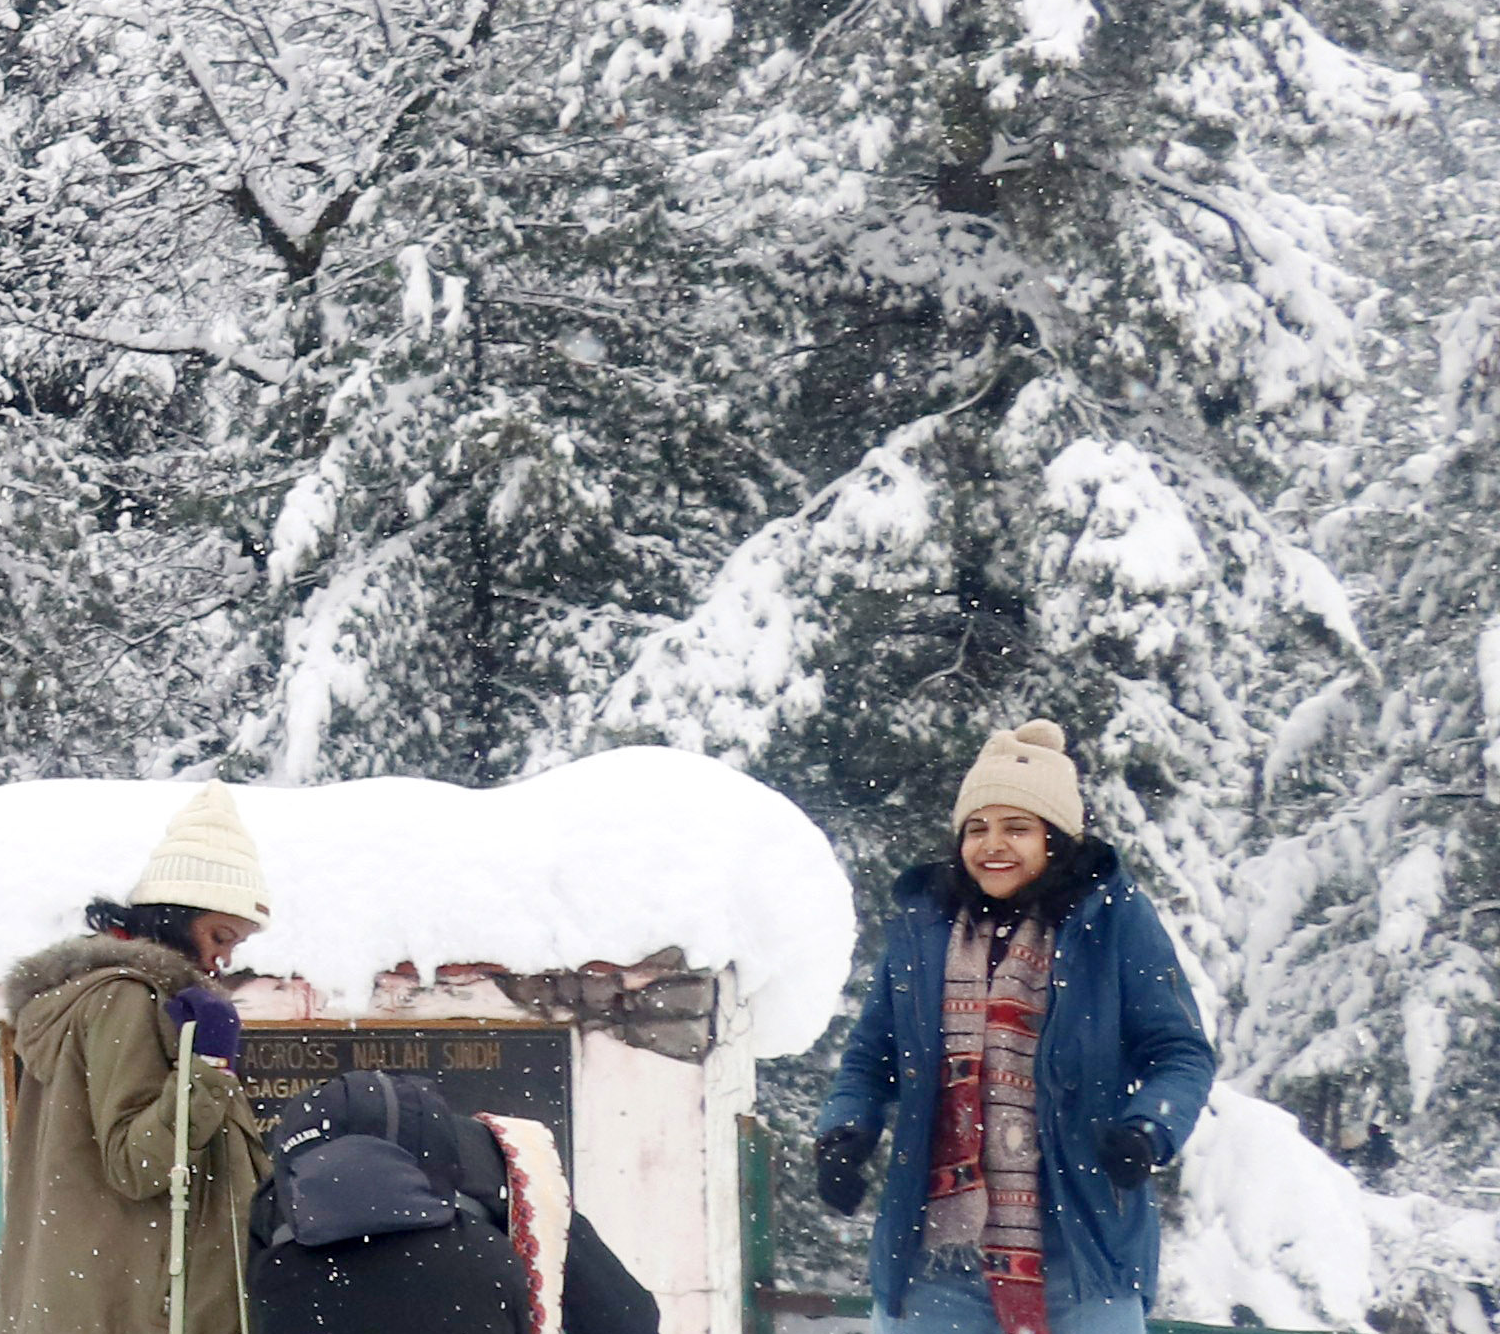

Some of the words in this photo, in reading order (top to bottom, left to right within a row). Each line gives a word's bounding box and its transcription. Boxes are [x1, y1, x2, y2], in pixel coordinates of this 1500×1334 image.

[244, 1041, 339, 1069] ACROSS
[352, 1041, 429, 1069] NALLAH
[442, 1041, 501, 1069] SINDH
